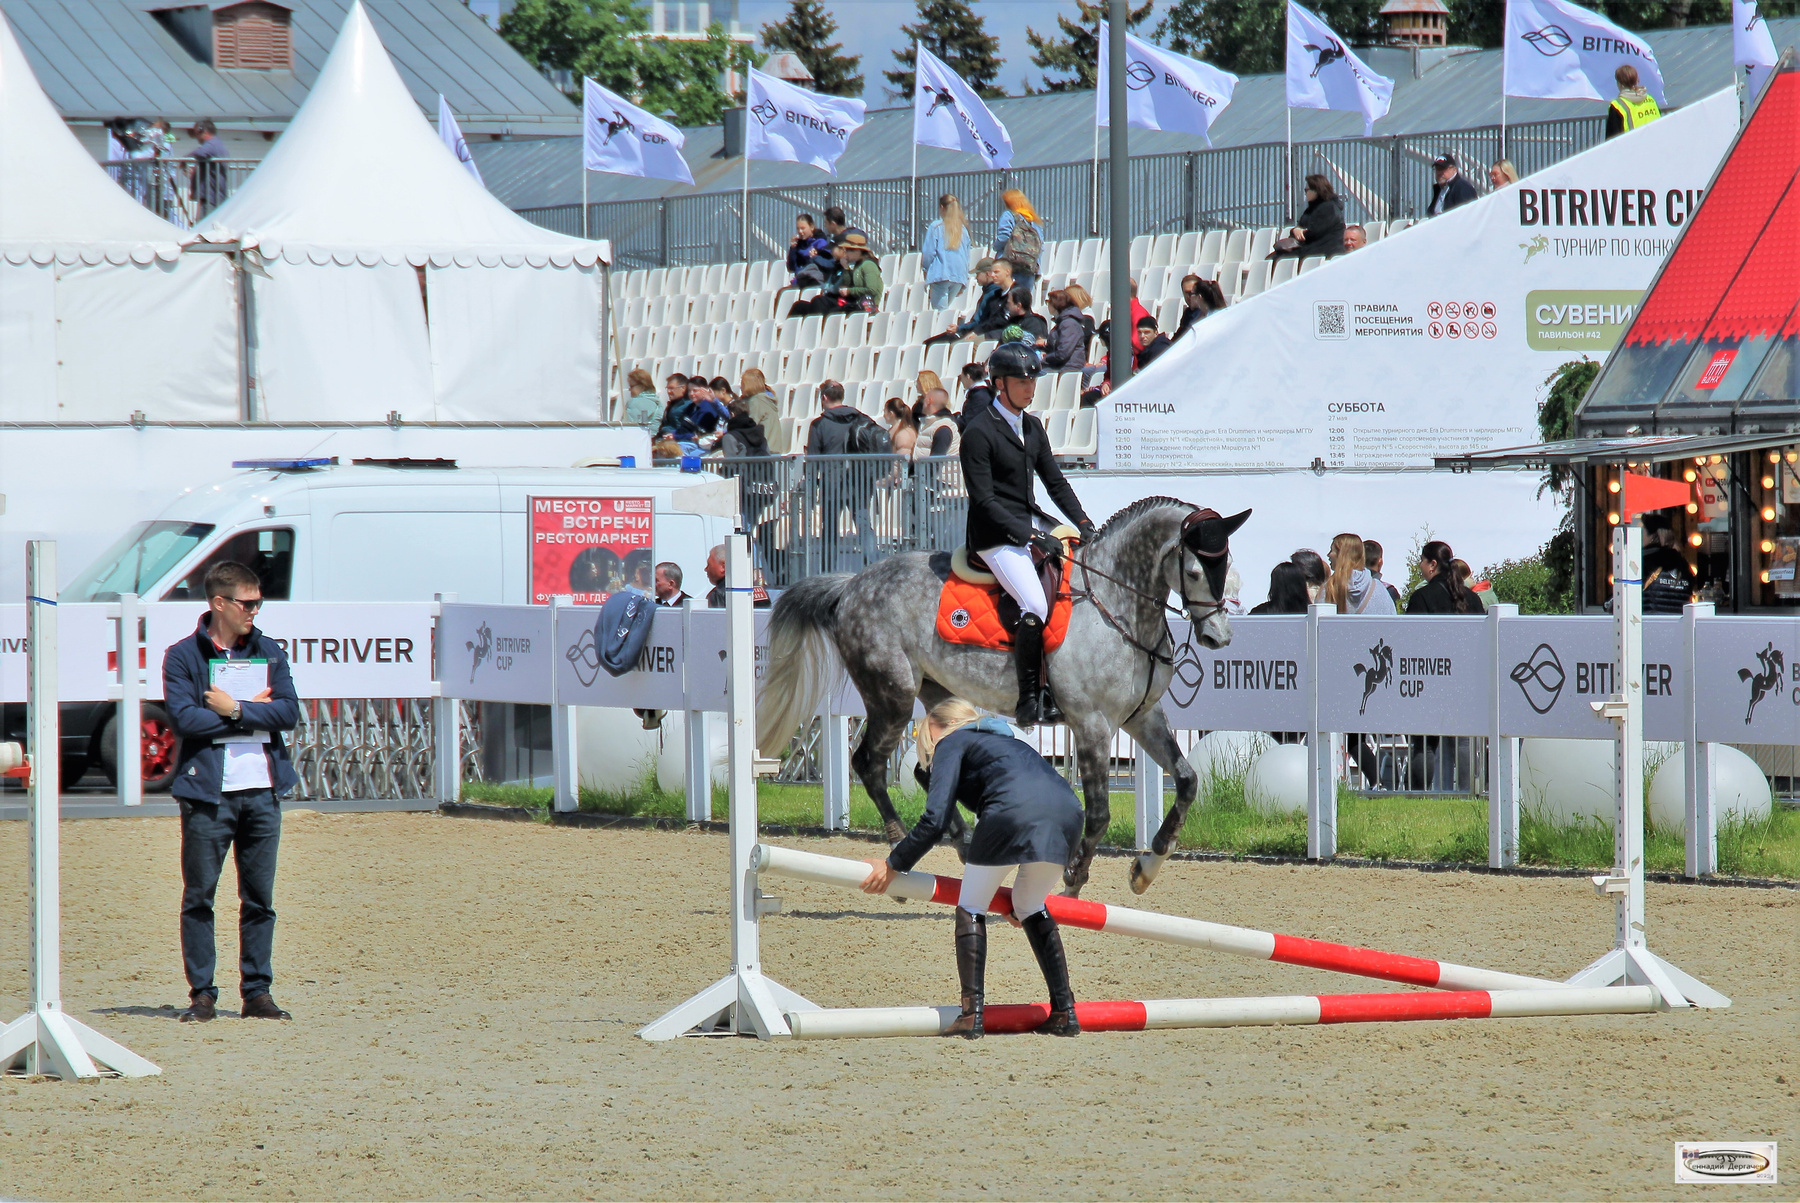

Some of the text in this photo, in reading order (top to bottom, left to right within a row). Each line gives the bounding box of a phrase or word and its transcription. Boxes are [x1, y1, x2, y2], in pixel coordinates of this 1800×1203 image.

[1519, 189, 1657, 227] BITRIVER
[1554, 238, 1607, 258] ТУРНИР
[1611, 239, 1630, 256] ПО
[1354, 304, 1398, 313] ПРАВИЛА
[1535, 304, 1638, 325] СУВЕНИ
[1355, 316, 1413, 325] ПОСЕЩЕНИЯ
[1355, 328, 1423, 336] МЕРОПРИЯТИЯ
[1538, 331, 1601, 339] ПАВИЛЬОН #42
[1114, 403, 1176, 415] ПЯТНИЦА
[1327, 402, 1386, 413] СУББОТА
[535, 500, 601, 512] МЕСТО
[563, 516, 650, 528] ВСТРЕЧИ
[535, 533, 649, 544] РЕСТОМАРКЕТ
[496, 637, 530, 653] BITRIVER
[496, 656, 512, 671] CUP
[1400, 657, 1451, 675] BITRIVER
[1213, 660, 1297, 690] BITRIVER
[1576, 662, 1672, 695] BITER
[1400, 680, 1424, 697] CUP
